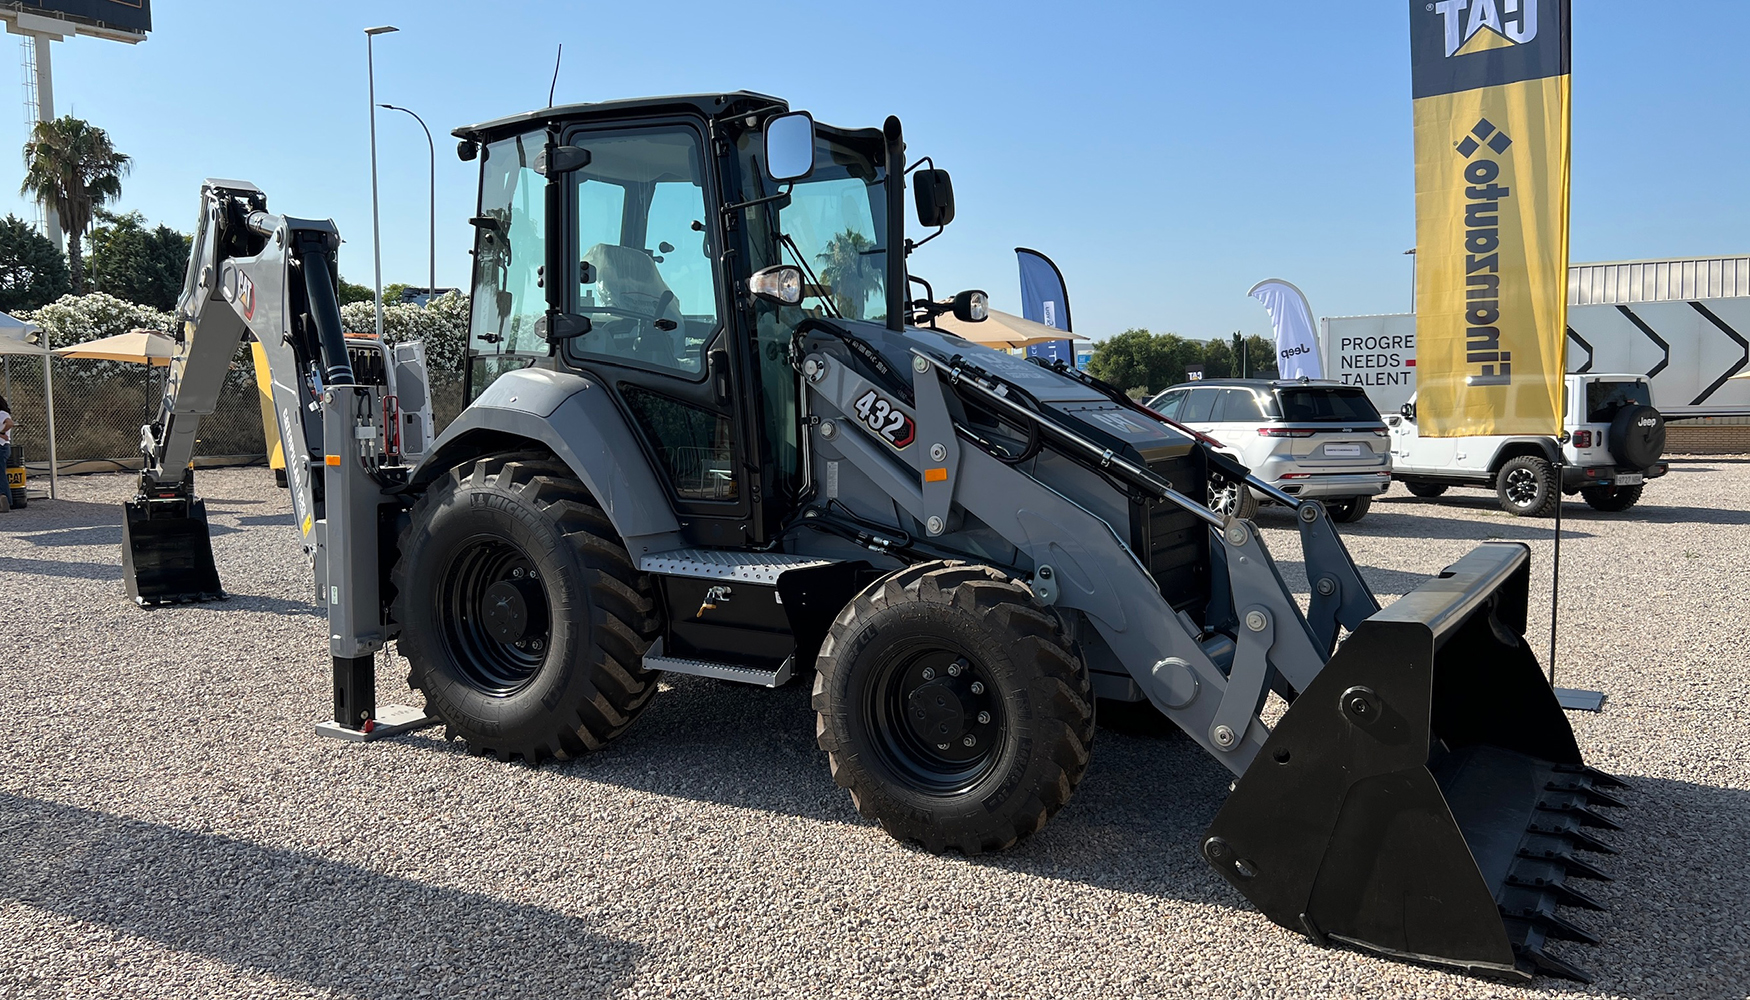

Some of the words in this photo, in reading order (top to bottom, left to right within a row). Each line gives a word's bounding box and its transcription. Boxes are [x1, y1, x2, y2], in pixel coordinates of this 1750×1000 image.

[238, 269, 253, 309] CAT
[1341, 335, 1415, 351] PROGRE
[1341, 353, 1400, 369] NEEDS
[1341, 371, 1411, 386] TALENT
[854, 390, 905, 442] 432
[1091, 413, 1150, 433] CAT
[1637, 416, 1656, 428] Jeep
[283, 407, 301, 489] CATERPILLAR
[7, 473, 23, 485] CAT
[487, 494, 557, 550] MICHELIN
[858, 625, 876, 645] CL
